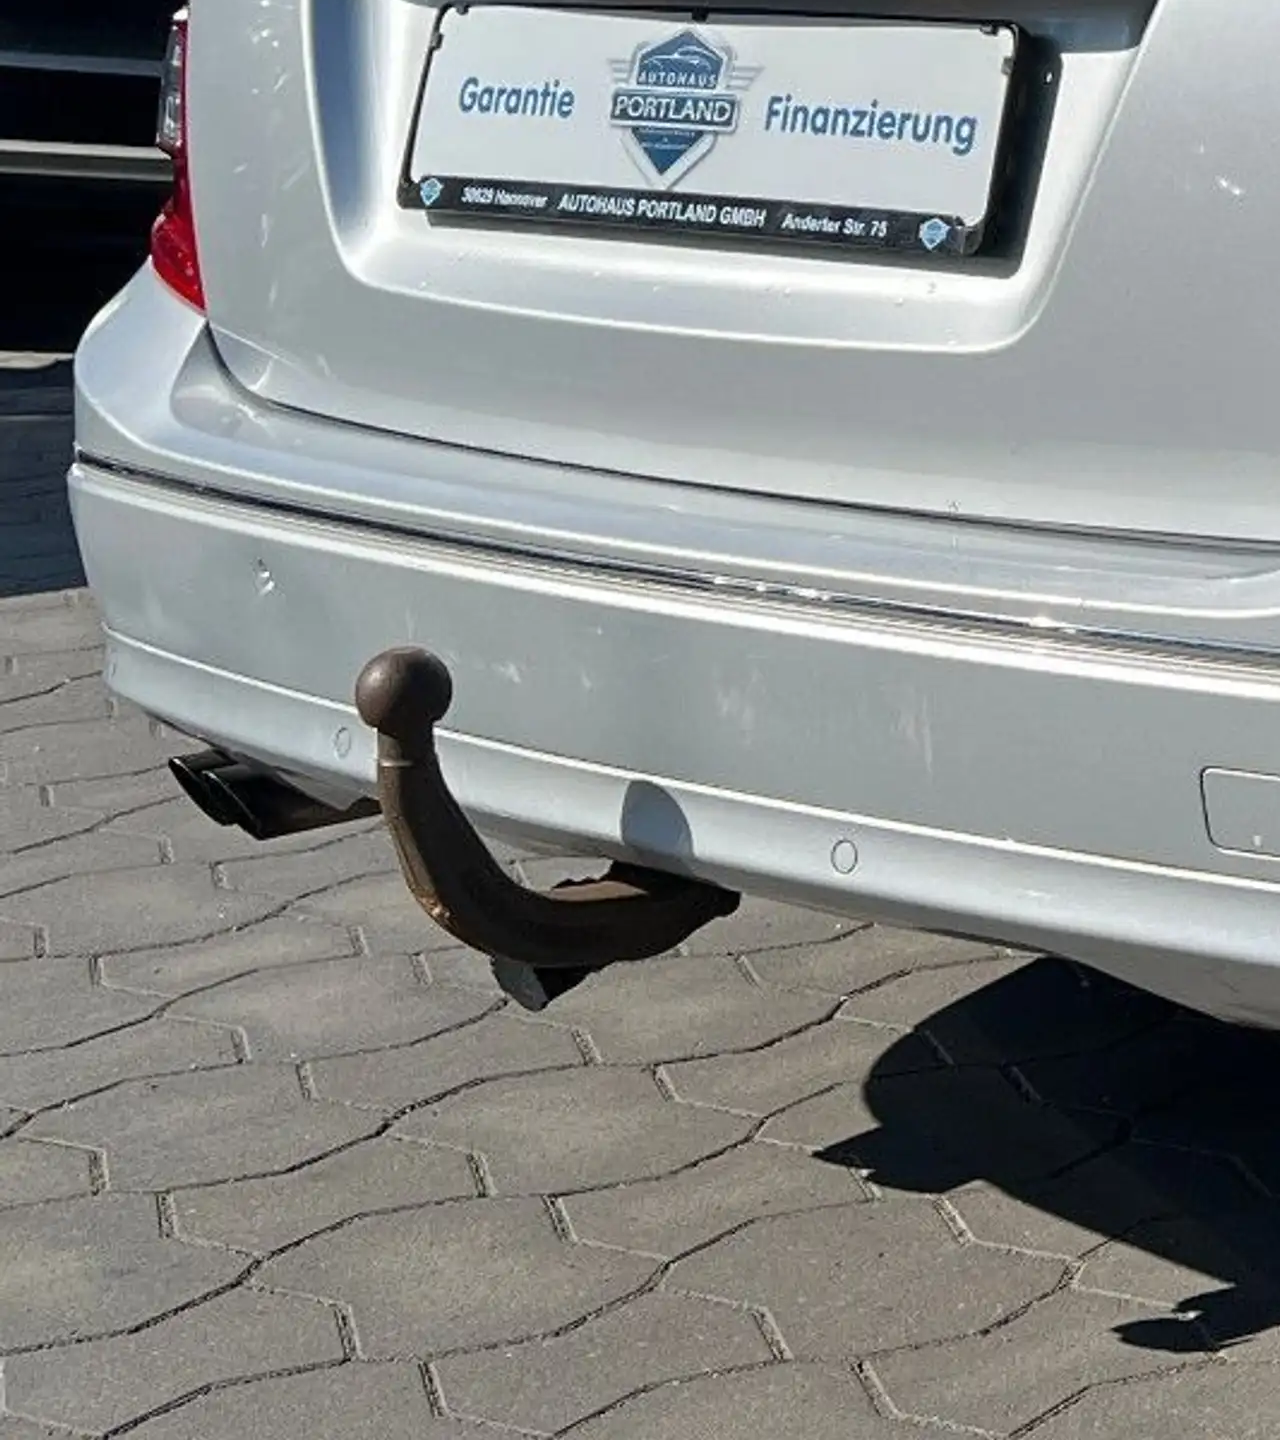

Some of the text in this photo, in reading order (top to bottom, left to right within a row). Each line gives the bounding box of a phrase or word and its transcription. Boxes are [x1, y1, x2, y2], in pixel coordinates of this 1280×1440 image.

[639, 71, 718, 89] AUTOHAUS
[459, 76, 575, 119] Garantie
[614, 96, 733, 123] PORTLAND
[765, 94, 978, 156] Finanzierung
[557, 193, 768, 228] AUTOHAUS PORTLAND GMBH
[781, 213, 888, 238] Anderter Str. 75
